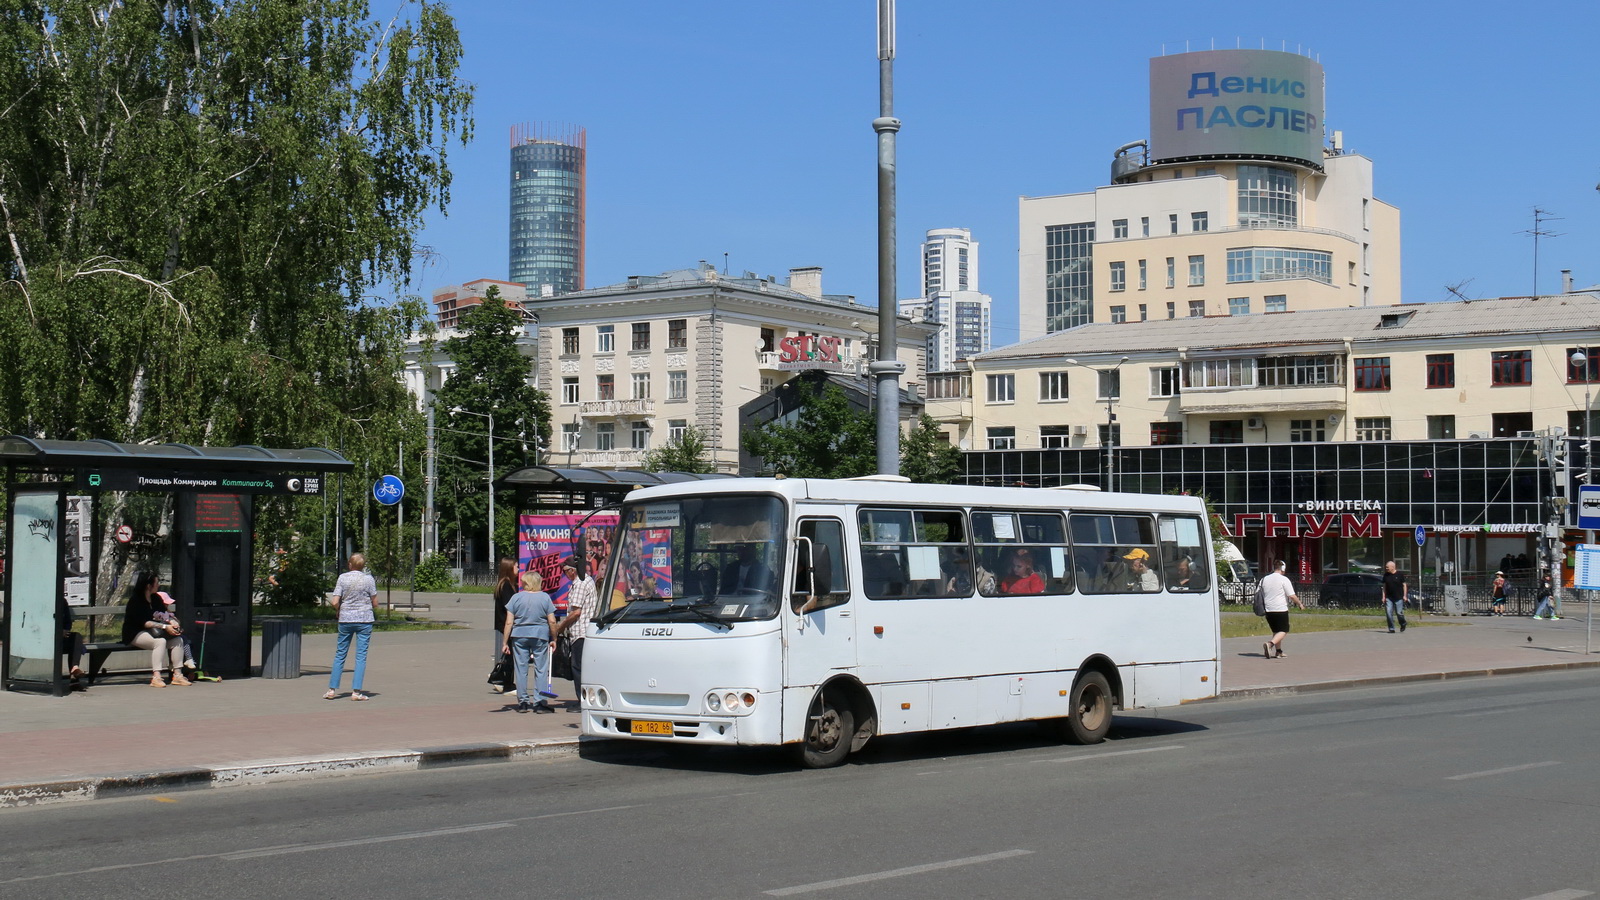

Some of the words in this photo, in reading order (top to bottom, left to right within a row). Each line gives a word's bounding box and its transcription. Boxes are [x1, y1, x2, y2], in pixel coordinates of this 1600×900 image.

[1188, 72, 1305, 99] Денис
[1177, 105, 1317, 134] ПАСЛЕР
[138, 476, 172, 485] Площадь
[173, 478, 217, 487] Коммунаров
[222, 479, 264, 487] Kommunarov
[265, 480, 275, 488] Sq.
[1306, 500, 1382, 511] ВИНОТЕКА
[526, 529, 537, 539] 14
[539, 529, 571, 539] ИЮНЯ
[526, 541, 549, 550] 16:00
[530, 553, 560, 570] LIKEE
[540, 564, 564, 578] ARTY
[541, 576, 560, 590] OUR
[641, 627, 674, 636] ISUZU
[646, 722, 659, 732] 182
[662, 722, 670, 730] 66
